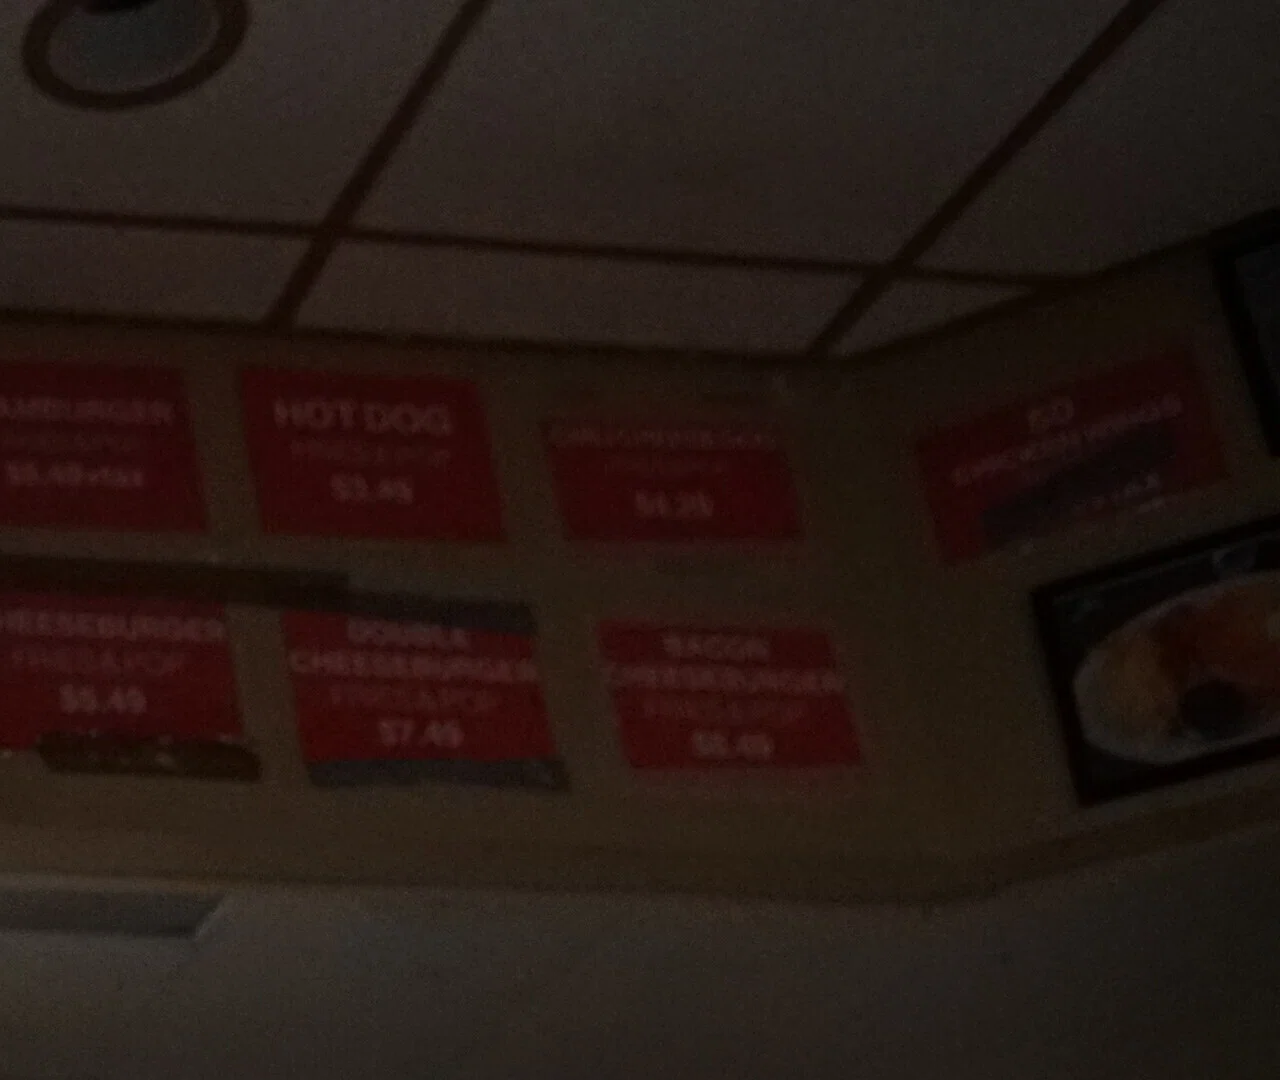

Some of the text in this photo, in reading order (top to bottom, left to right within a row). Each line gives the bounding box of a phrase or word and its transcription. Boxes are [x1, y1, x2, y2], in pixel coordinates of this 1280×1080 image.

[273, 397, 454, 437] HOT DOG
[290, 650, 537, 684] CHEESEBURGER
